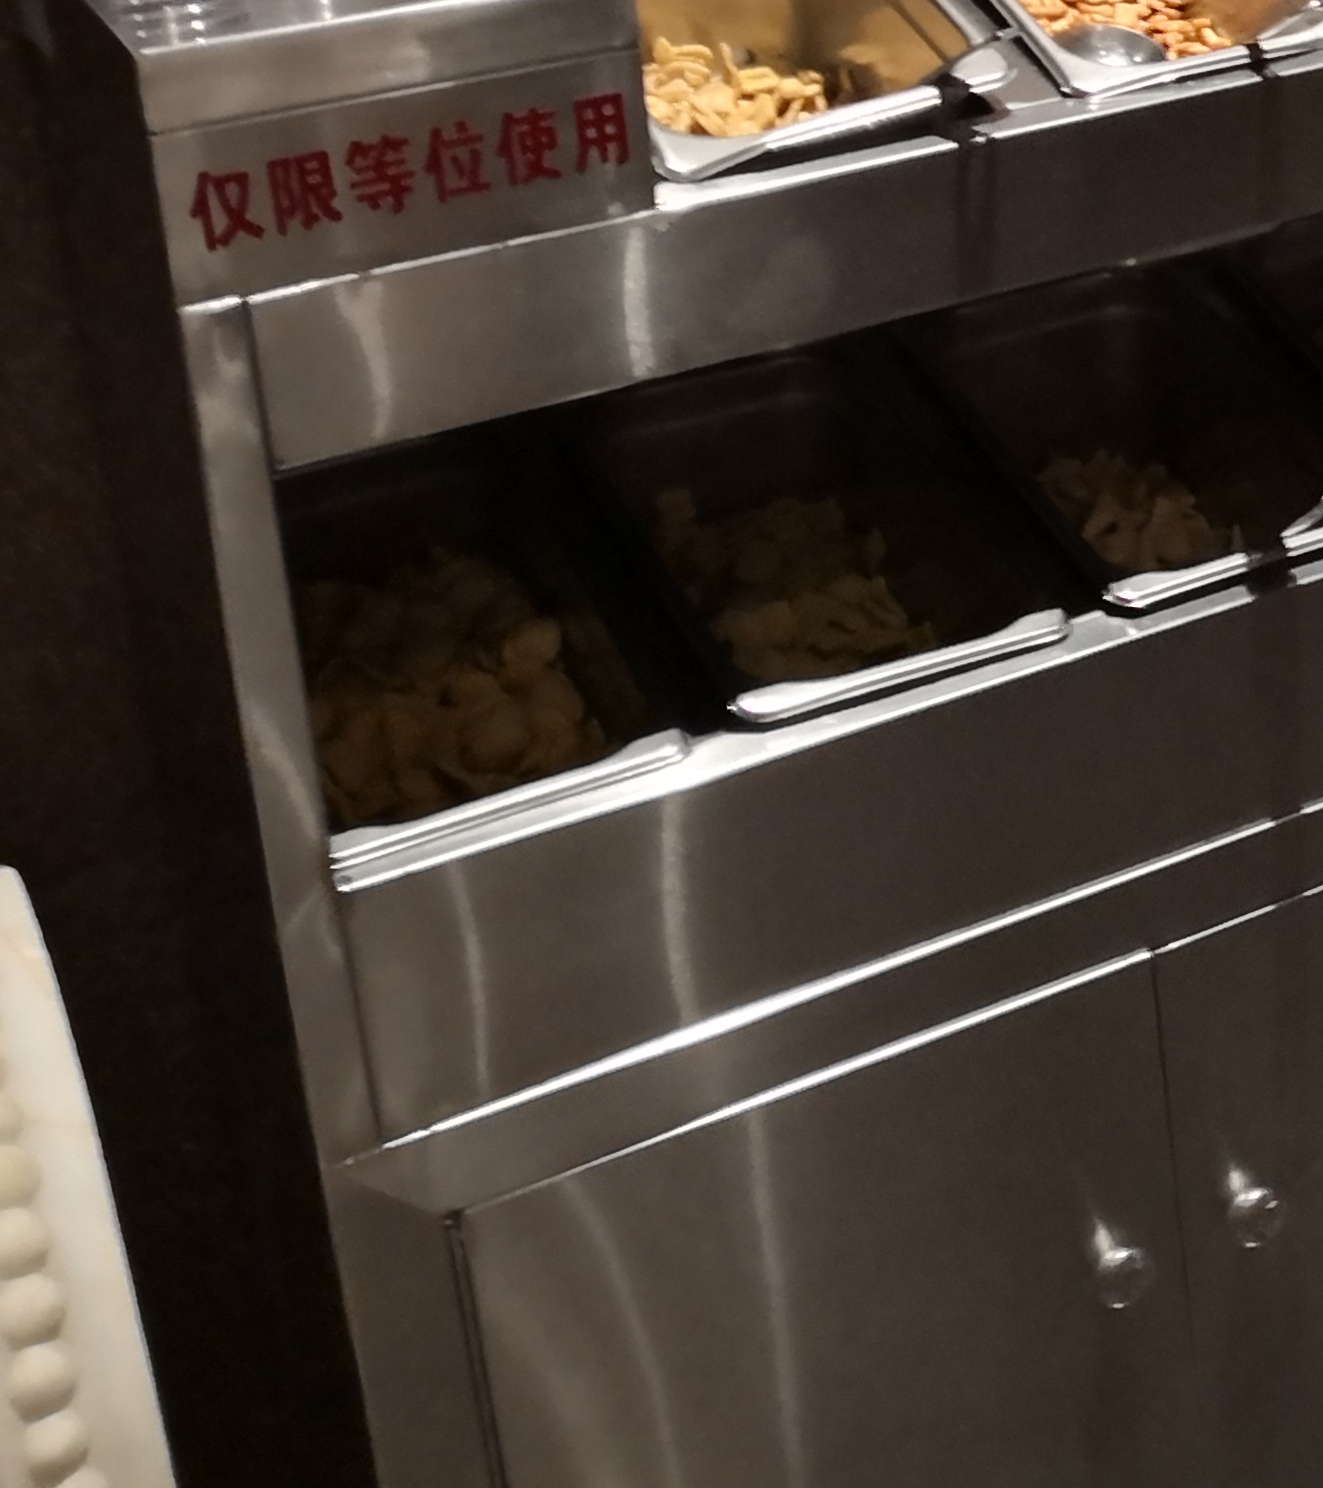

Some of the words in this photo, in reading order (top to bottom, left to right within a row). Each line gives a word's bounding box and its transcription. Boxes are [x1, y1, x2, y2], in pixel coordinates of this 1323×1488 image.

[188, 92, 630, 252] 仅限等位使用
